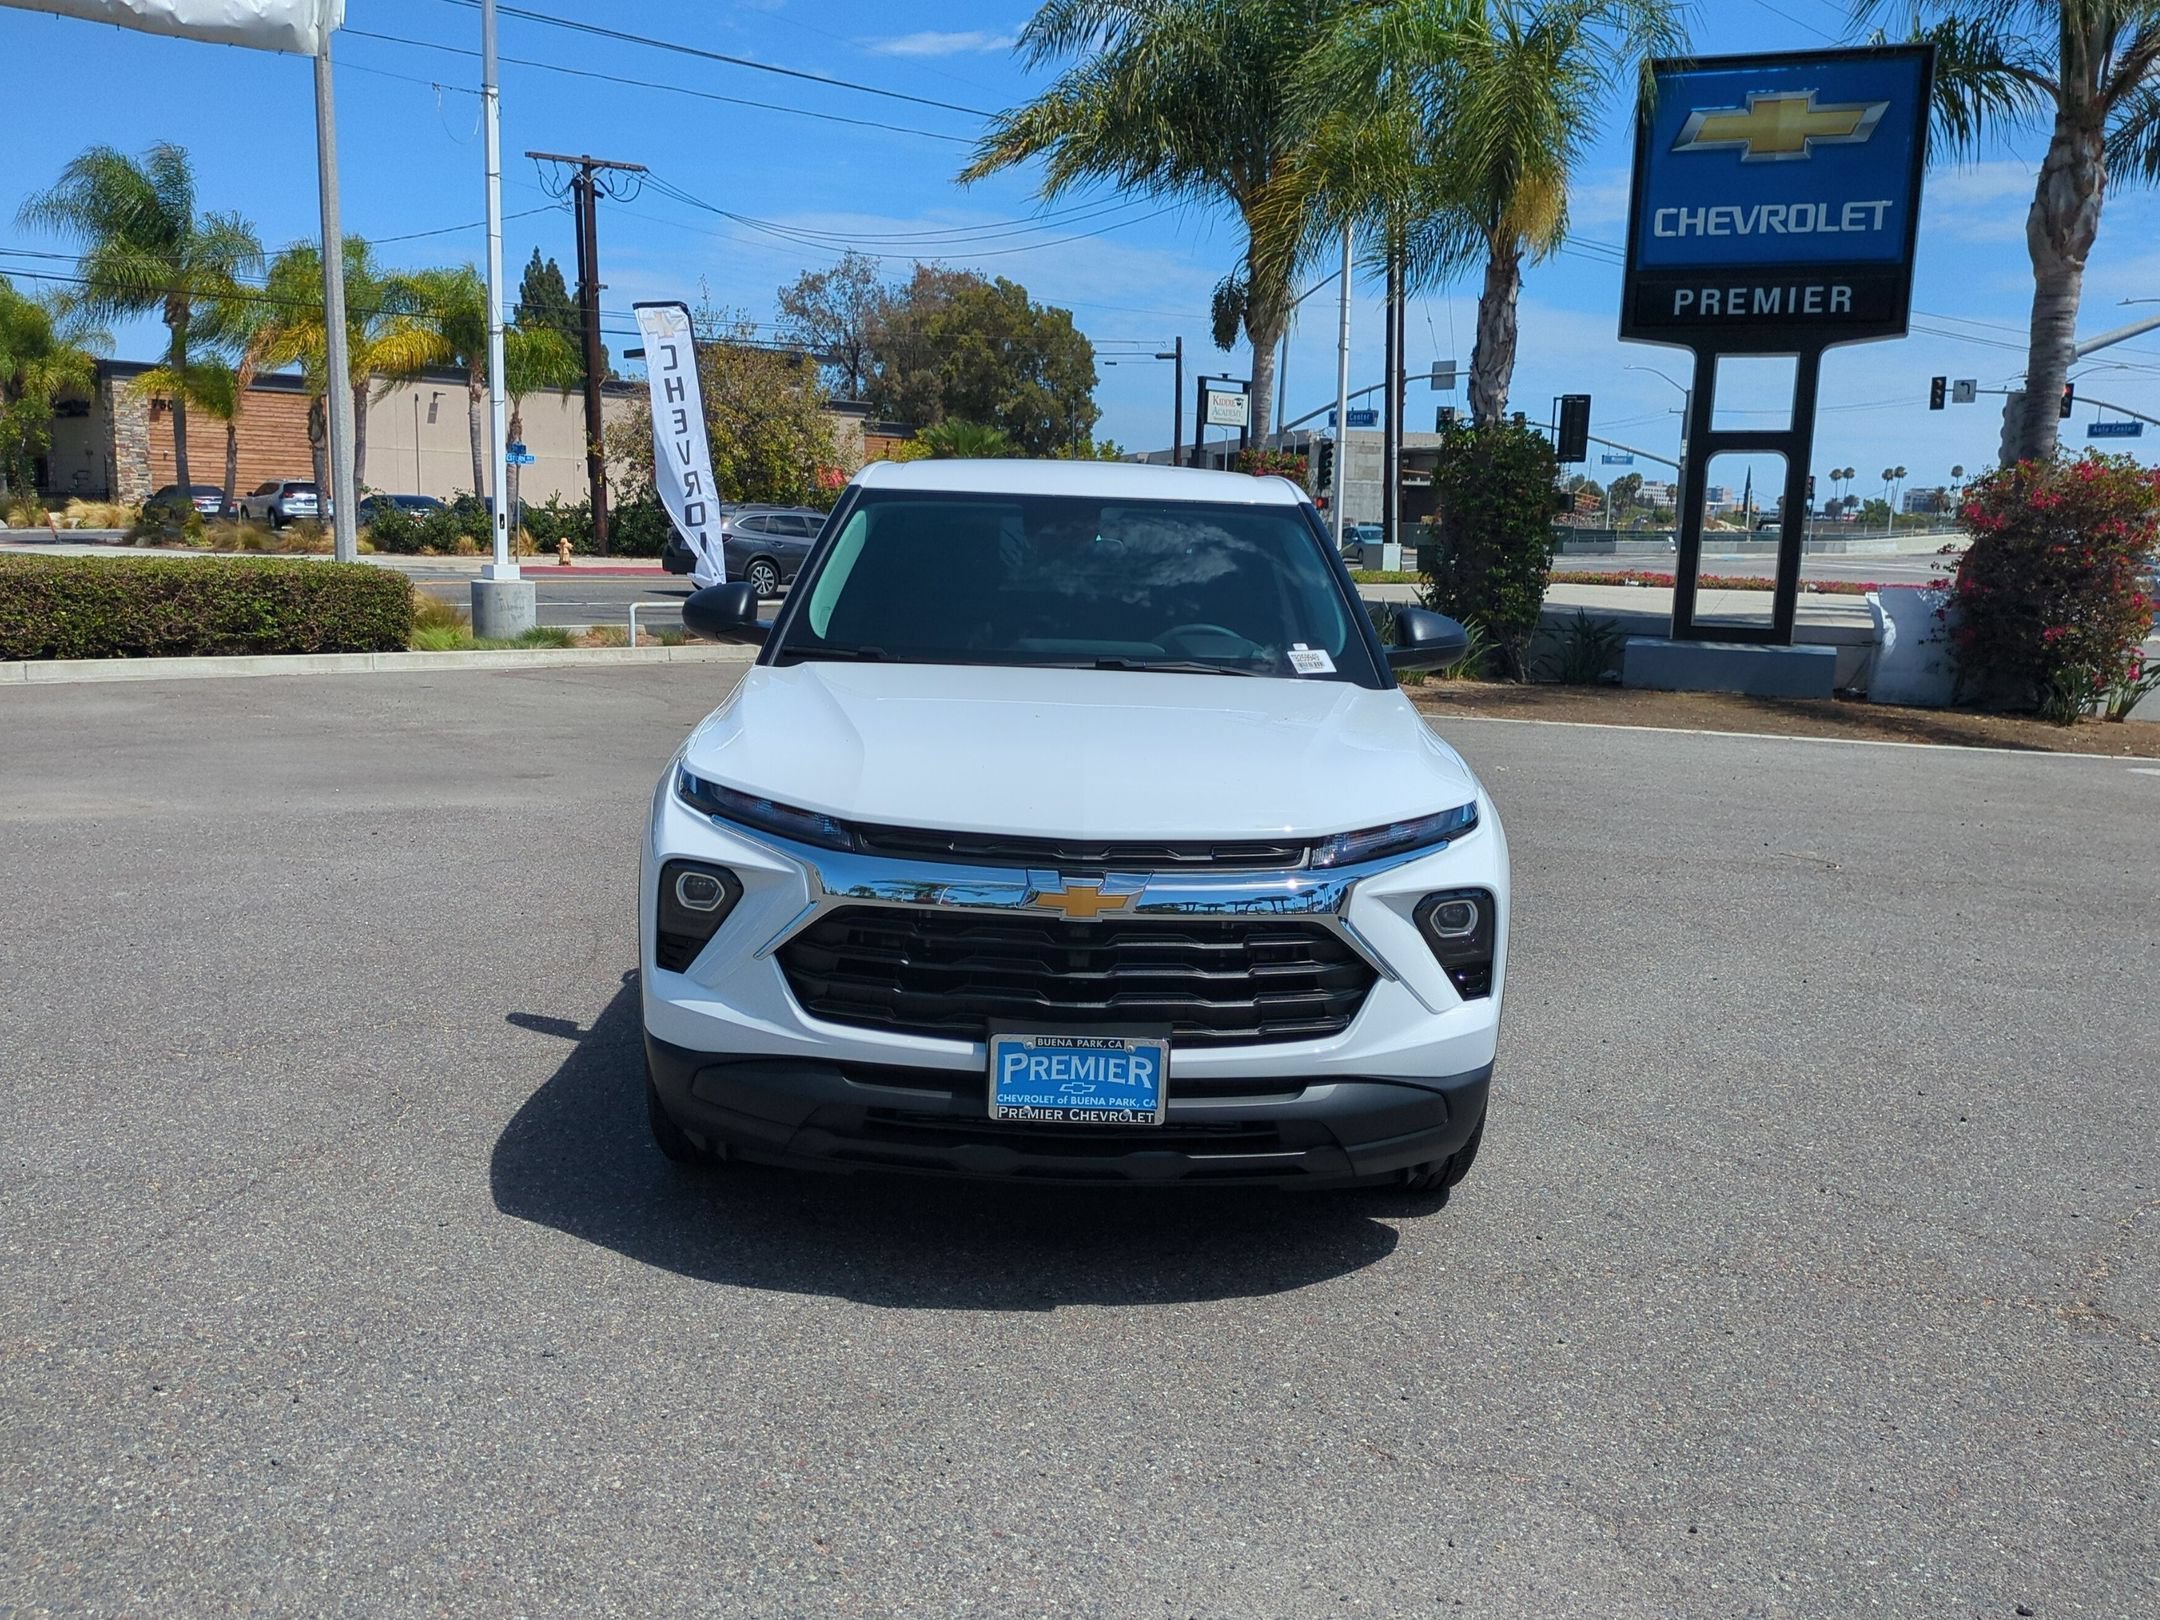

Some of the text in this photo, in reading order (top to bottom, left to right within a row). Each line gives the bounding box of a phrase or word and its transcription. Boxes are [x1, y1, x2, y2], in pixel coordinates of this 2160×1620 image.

[1653, 200, 1893, 238] CHEVROLET
[1673, 286, 1853, 316] PREMIER
[1037, 1037, 1123, 1050] BUENA PARK, CA
[1002, 1052, 1154, 1090] PREMIER
[997, 1093, 1157, 1108] CHEVROLET of BUENA PARK, CA
[997, 1105, 1155, 1124] PREMIER CHEVROLET
